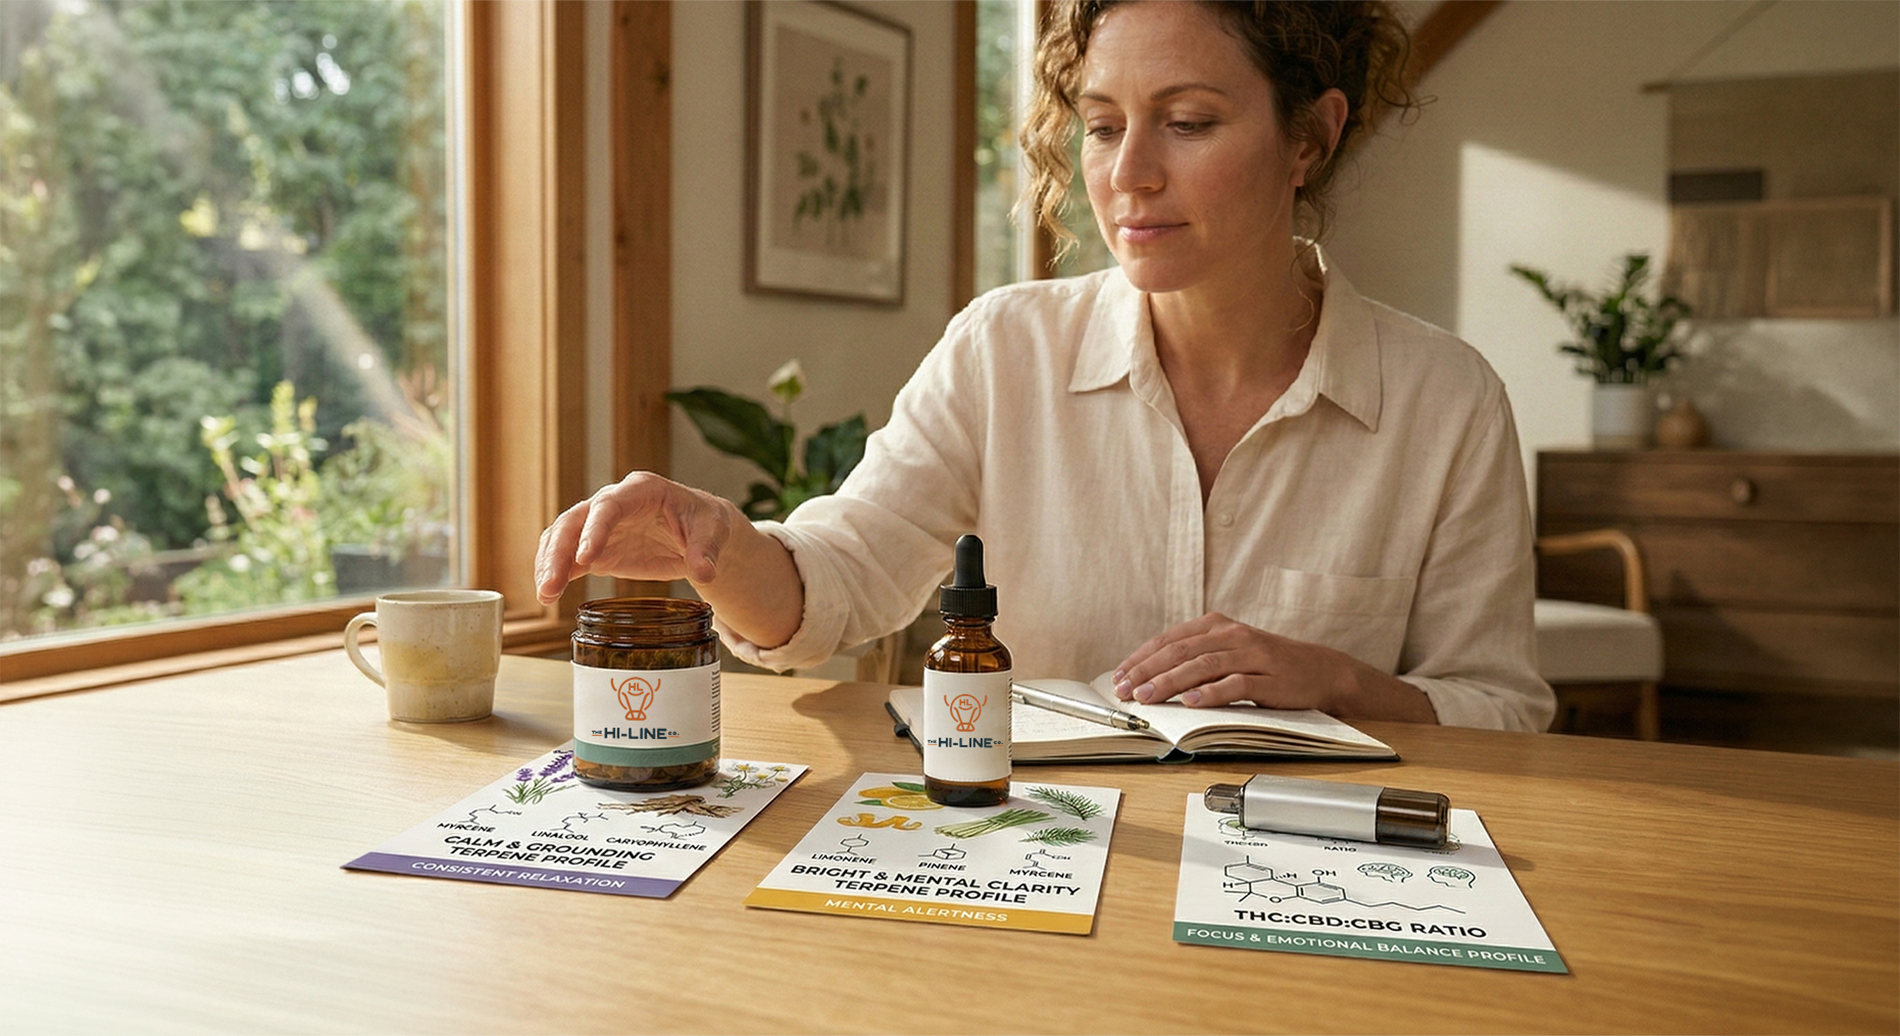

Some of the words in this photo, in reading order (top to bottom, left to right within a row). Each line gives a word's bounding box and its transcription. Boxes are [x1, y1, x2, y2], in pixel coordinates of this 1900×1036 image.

[628, 682, 644, 691] HL
[959, 698, 973, 706] HL
[604, 727, 667, 739] HI-LINE
[938, 737, 993, 748] HI-LINE
[437, 823, 496, 833] MYRCENE
[531, 830, 590, 841] LINALOOL
[444, 836, 504, 848] CALM
[506, 841, 521, 849] &
[526, 843, 656, 861] GROUNDING
[606, 837, 707, 851] CARYOPHYLLENE
[450, 846, 540, 861] TERPENE
[541, 855, 628, 869] PROFILE
[811, 853, 877, 865] LIMONENE
[918, 862, 967, 871] PINENE
[411, 861, 518, 878] CONSISTENT
[517, 872, 626, 889] RELAXATION
[791, 865, 871, 879] BRIGHT
[873, 872, 888, 881] &
[894, 873, 981, 889] MENTAL
[987, 880, 1081, 896] CLARITY
[1009, 869, 1073, 880] MYRCENE
[834, 879, 931, 896] TERPENE
[935, 888, 1028, 904] PROFILE
[825, 899, 898, 913] MENTAL
[902, 906, 1008, 922] ALERTNESS
[1234, 910, 1402, 932] THC:CBD:CBG
[1410, 923, 1487, 938] RATIO
[1187, 929, 1245, 941] FOCUS
[1250, 934, 1261, 942] &
[1267, 935, 1373, 951] EMOTIONAL
[1377, 943, 1464, 959] BALANCE
[1467, 950, 1547, 965] PROFILE
